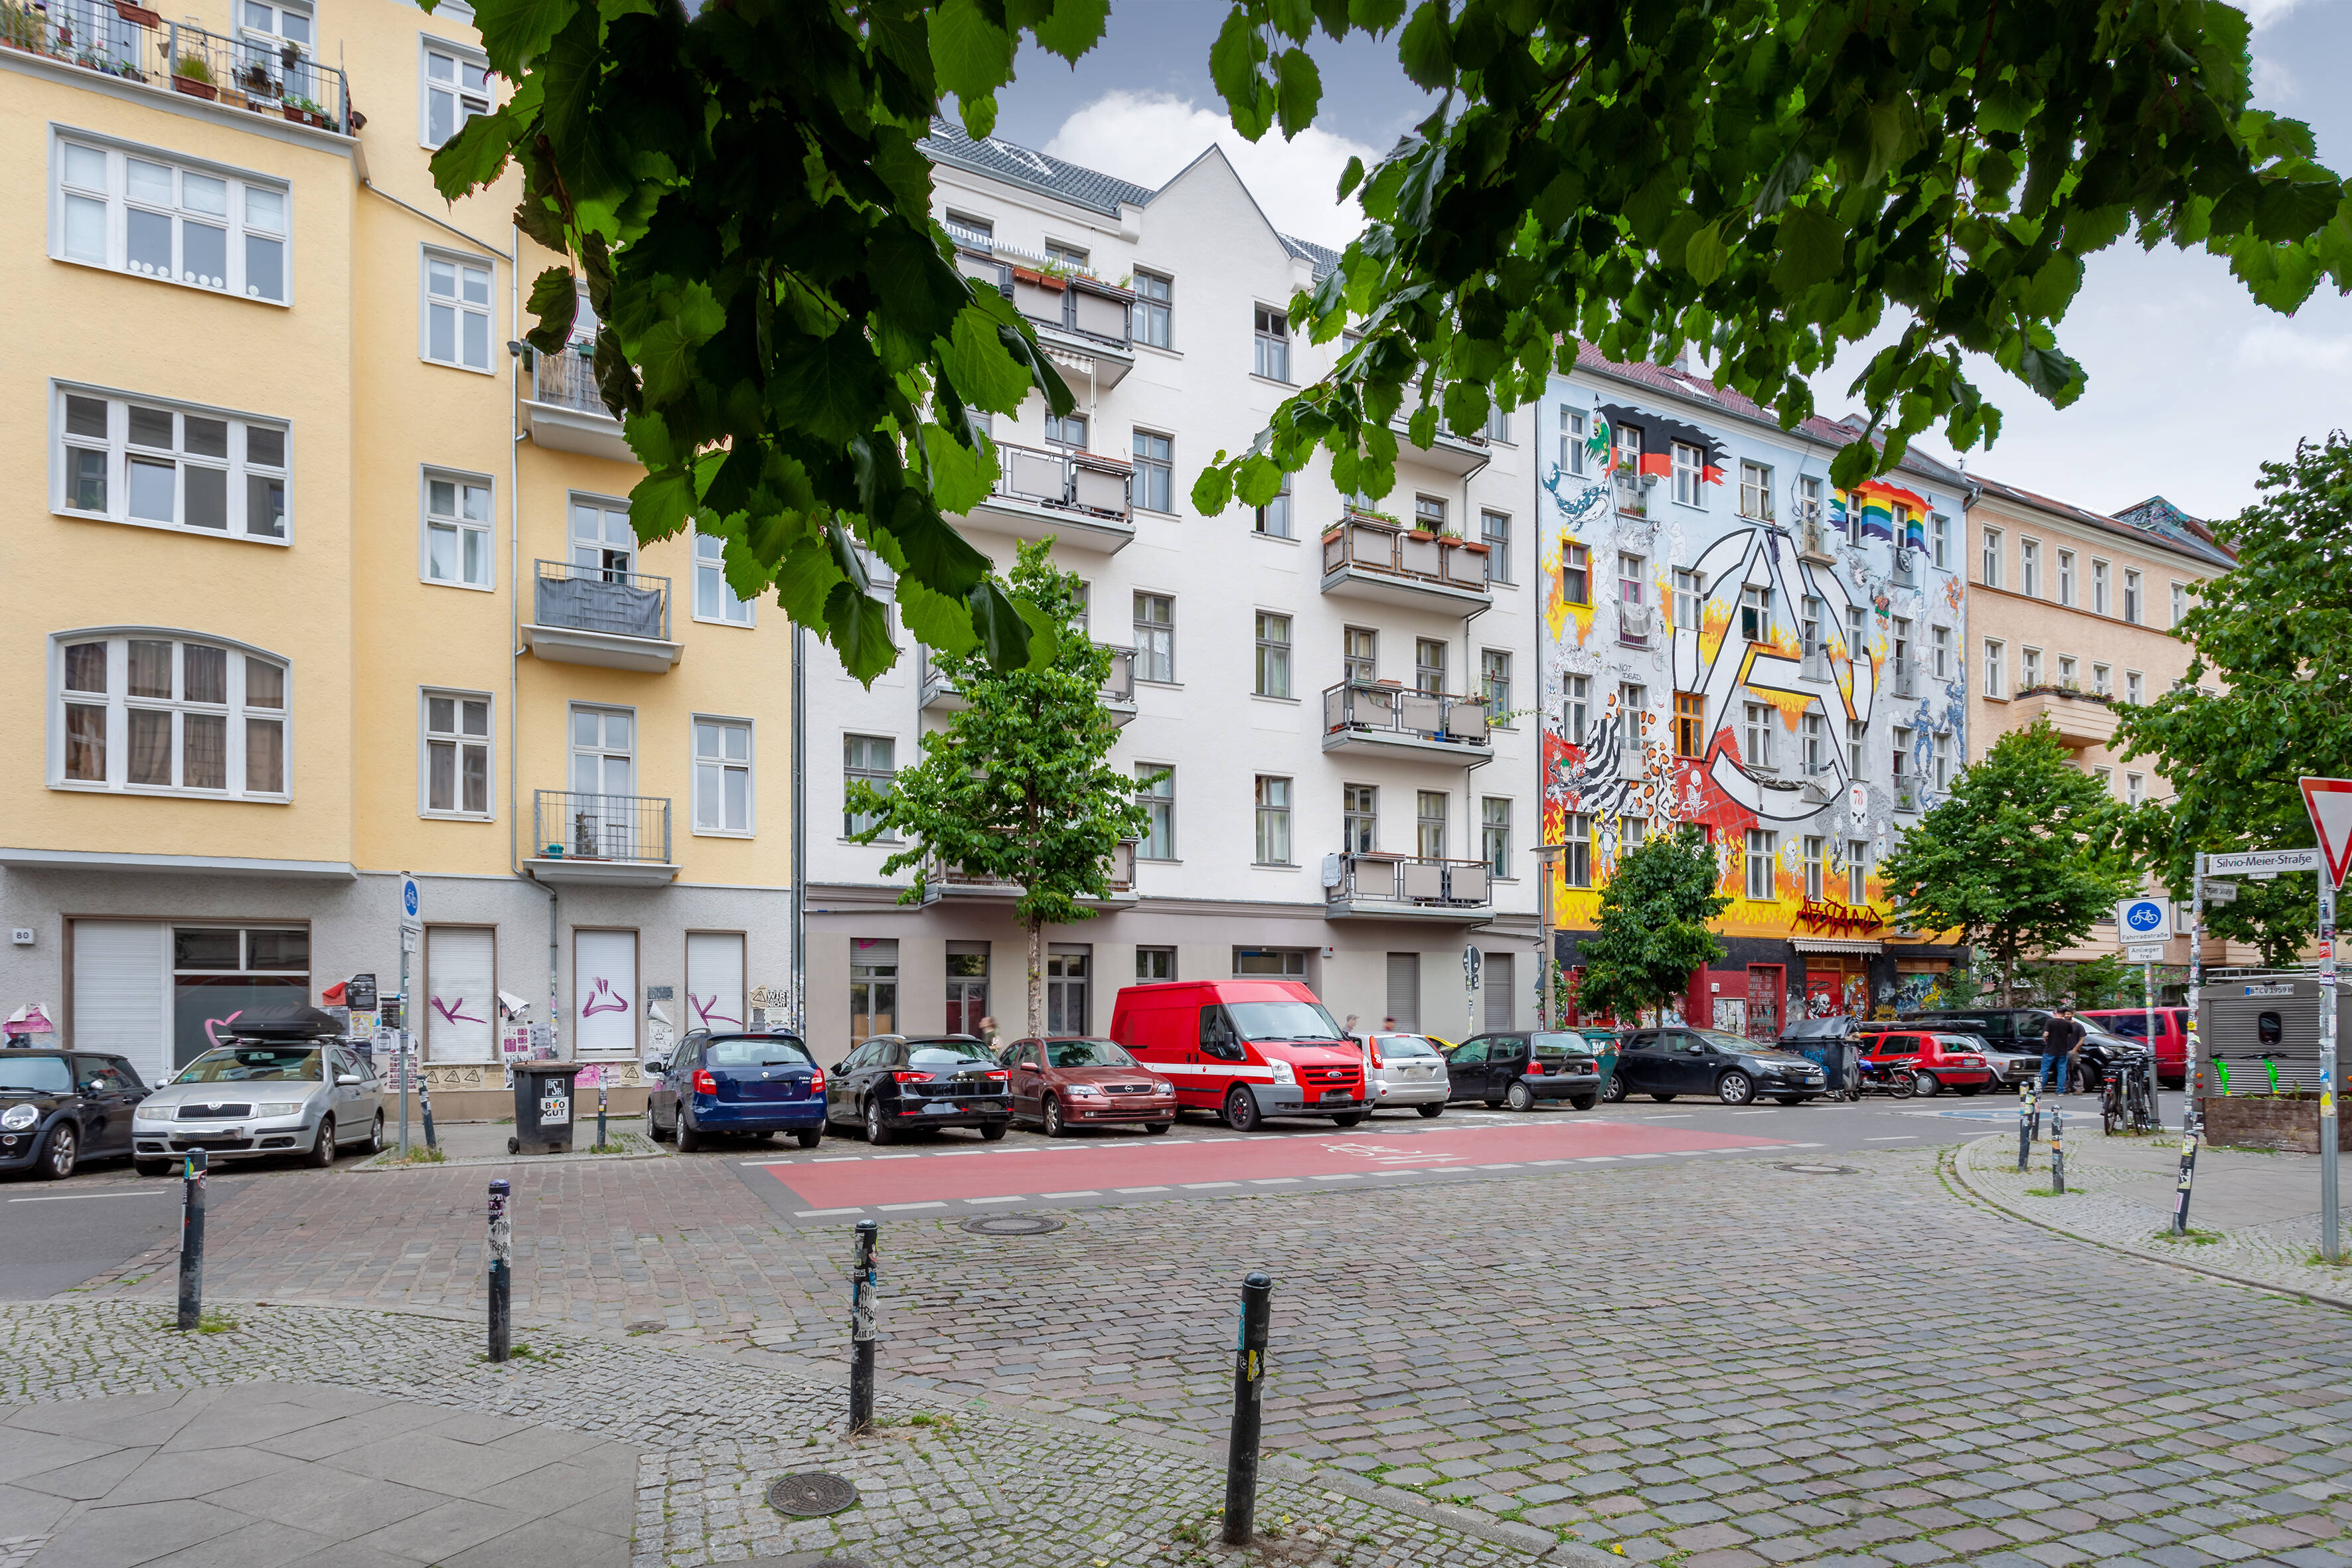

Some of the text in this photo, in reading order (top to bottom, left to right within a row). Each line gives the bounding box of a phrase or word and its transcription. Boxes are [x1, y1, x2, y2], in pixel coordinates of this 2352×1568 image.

[1619, 663, 1632, 672] NOT
[1853, 790, 1863, 805] 78
[2217, 853, 2312, 868] Silvio-Meier-Straße
[548, 1081, 562, 1095] BSR
